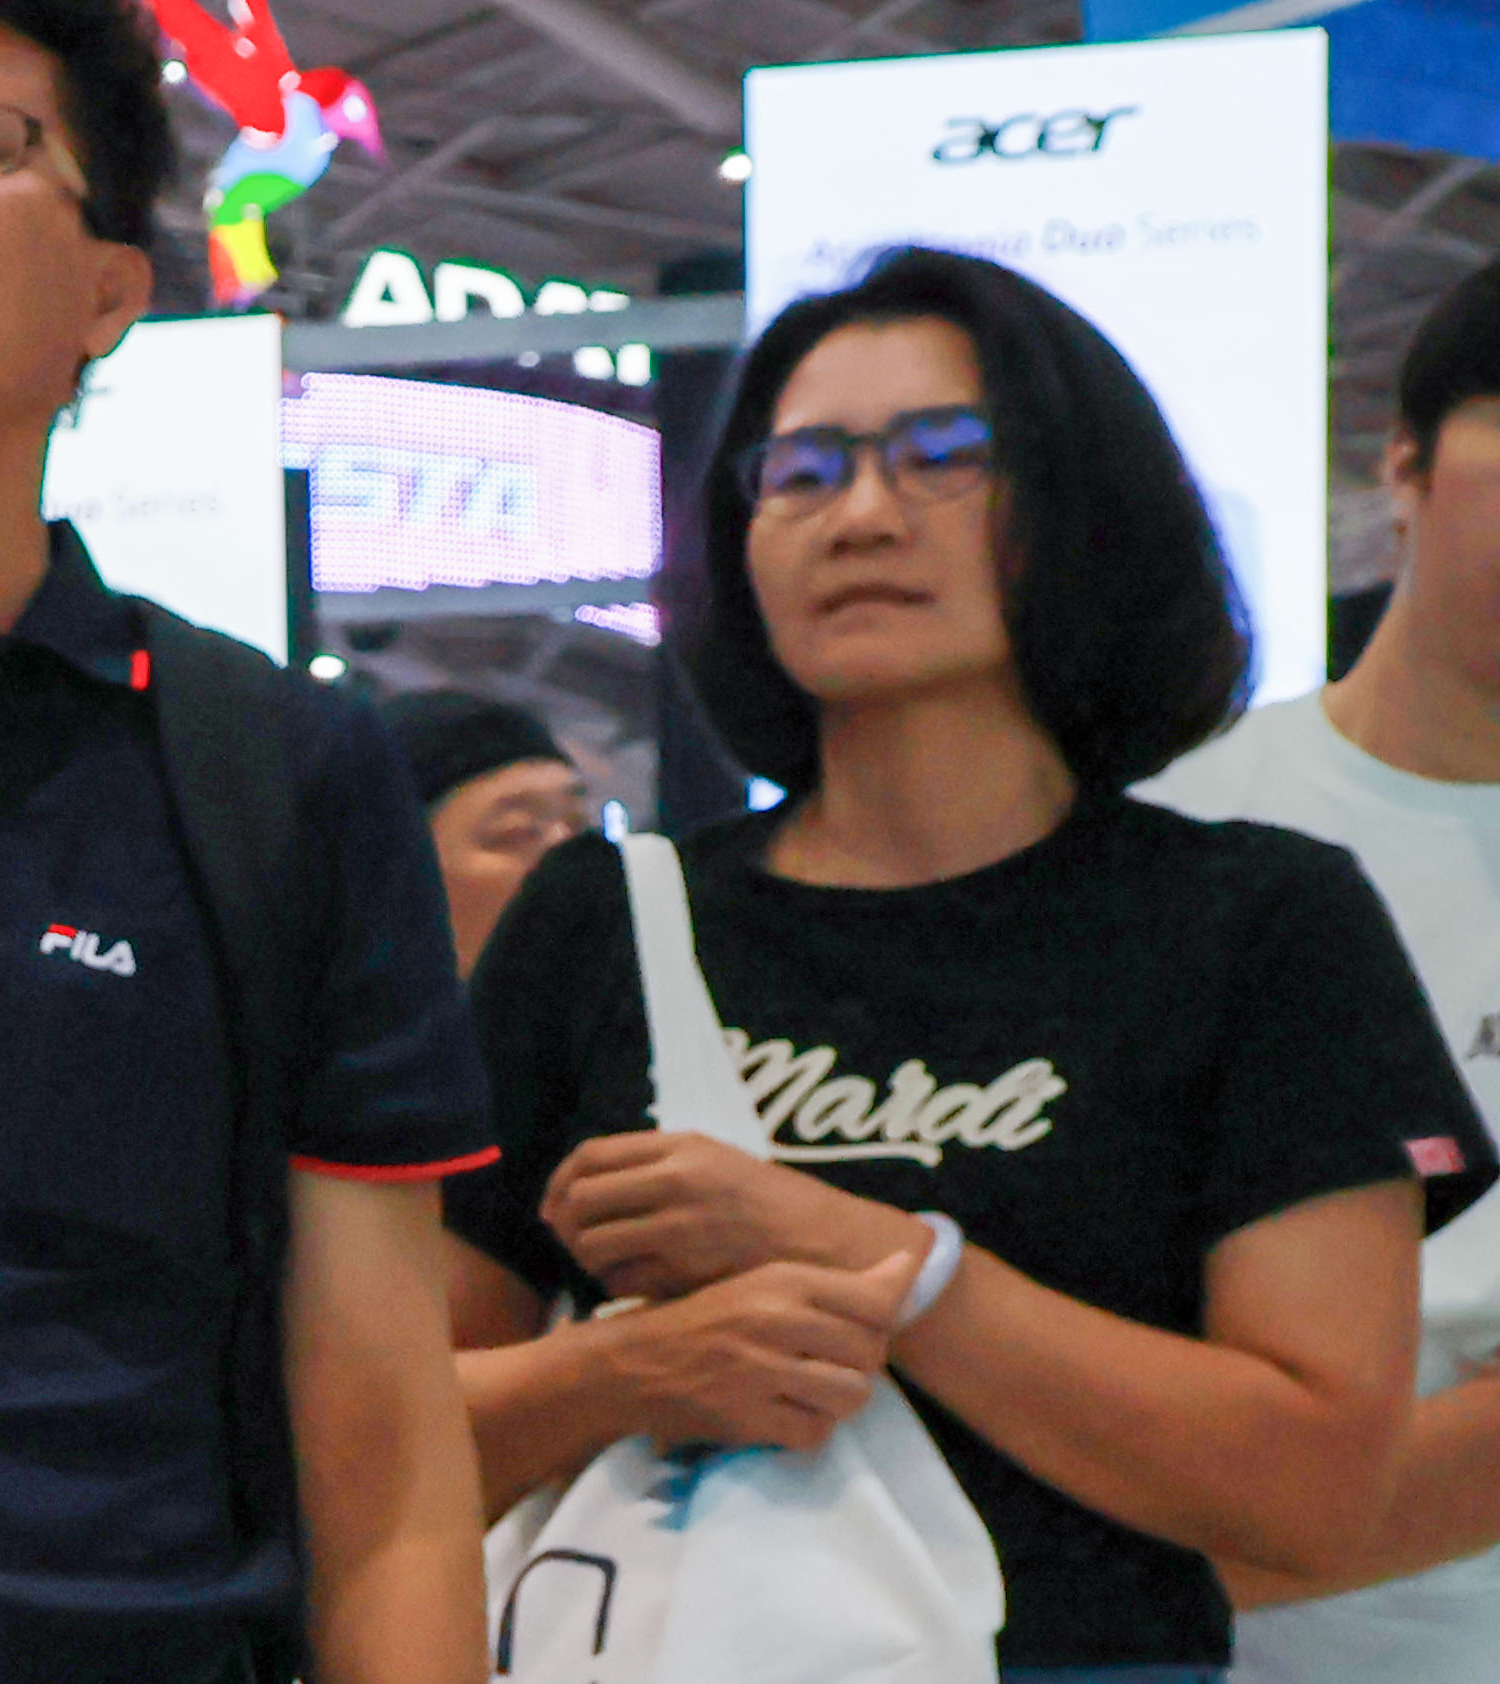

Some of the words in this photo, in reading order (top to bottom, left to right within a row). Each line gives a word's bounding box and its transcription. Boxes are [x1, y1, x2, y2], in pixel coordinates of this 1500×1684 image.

[931, 103, 1140, 164] acer
[40, 922, 137, 977] FILA
[722, 1027, 1068, 1168] Mardi
